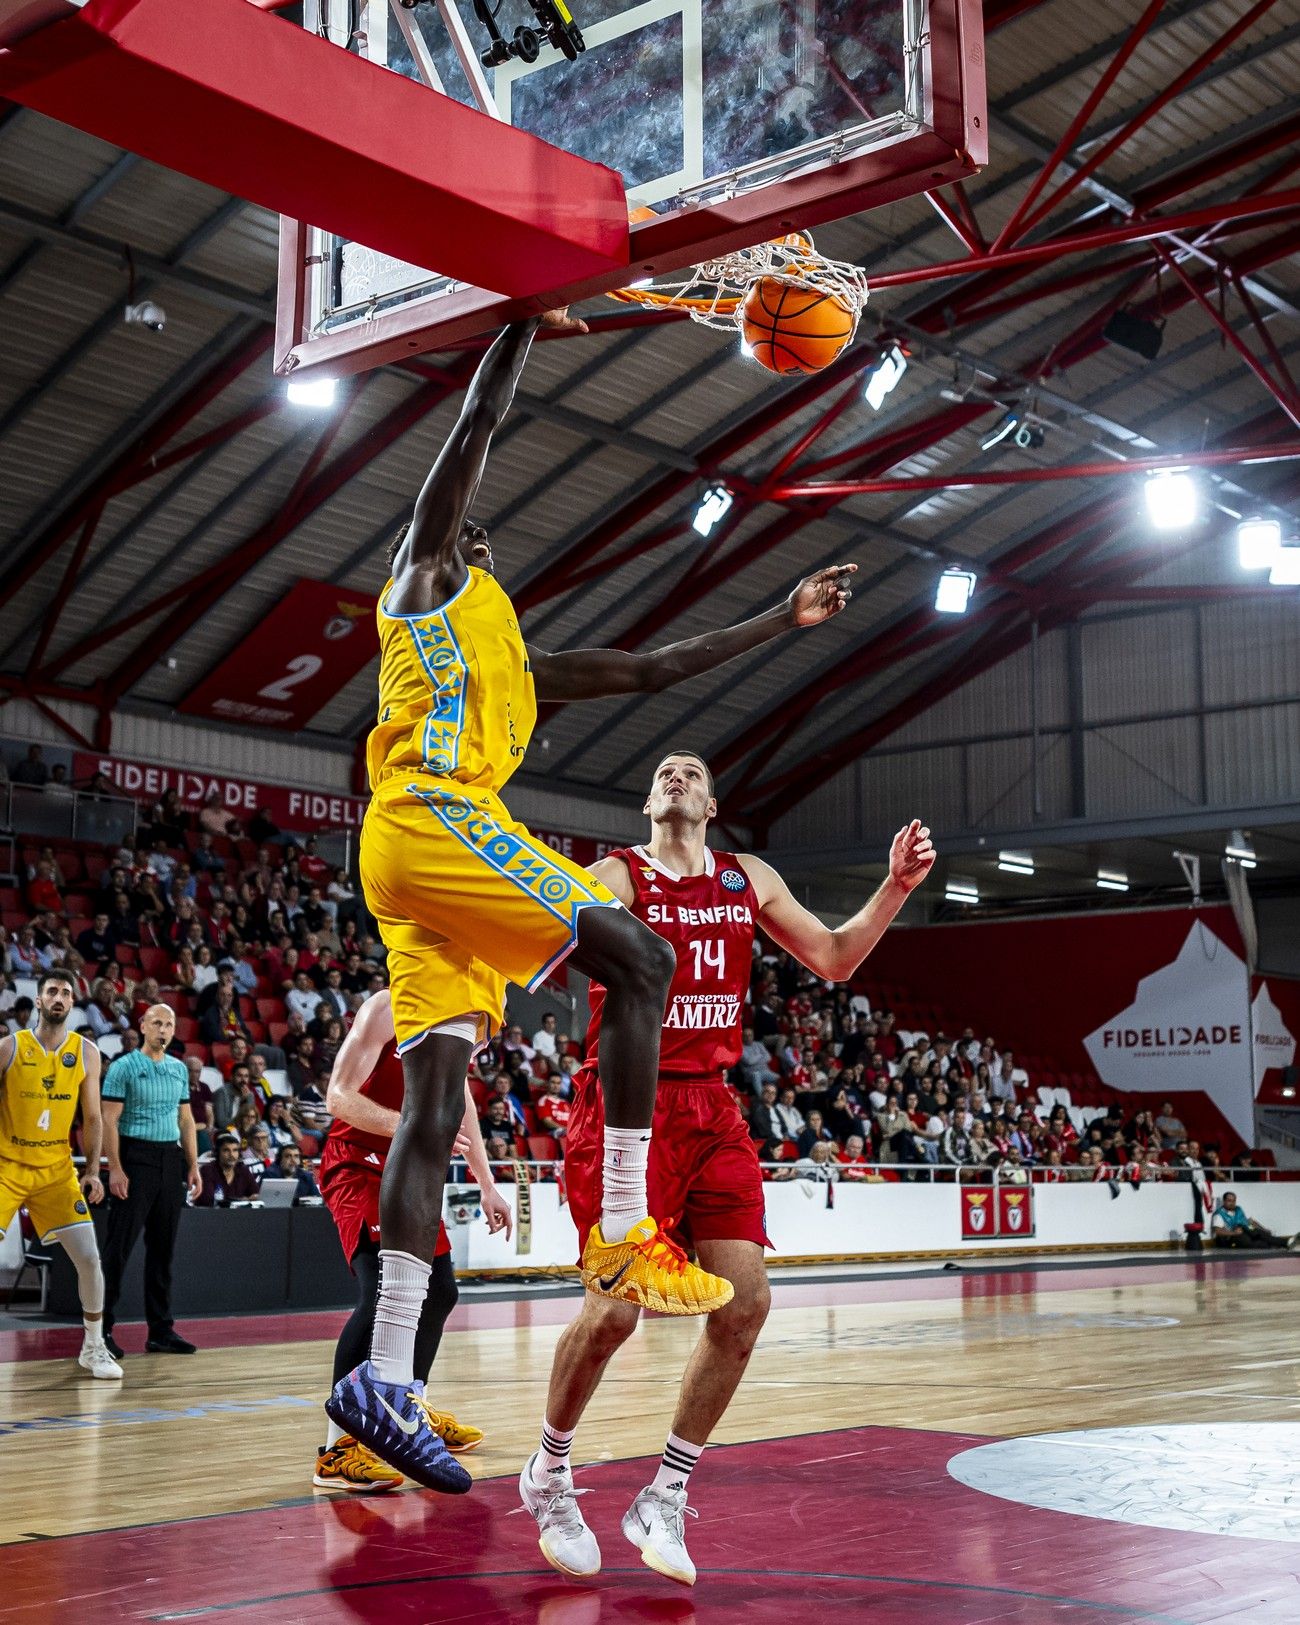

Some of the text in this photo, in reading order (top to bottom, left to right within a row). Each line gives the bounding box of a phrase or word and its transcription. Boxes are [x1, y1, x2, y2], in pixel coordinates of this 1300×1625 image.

[257, 654, 323, 700] 2
[288, 792, 364, 825] FIDELI
[647, 904, 753, 926] SL BENFICA
[689, 939, 726, 980] 14
[673, 993, 738, 1004] conservas
[1103, 1025, 1242, 1049] FIDELIDADE
[37, 1108, 51, 1132] 4
